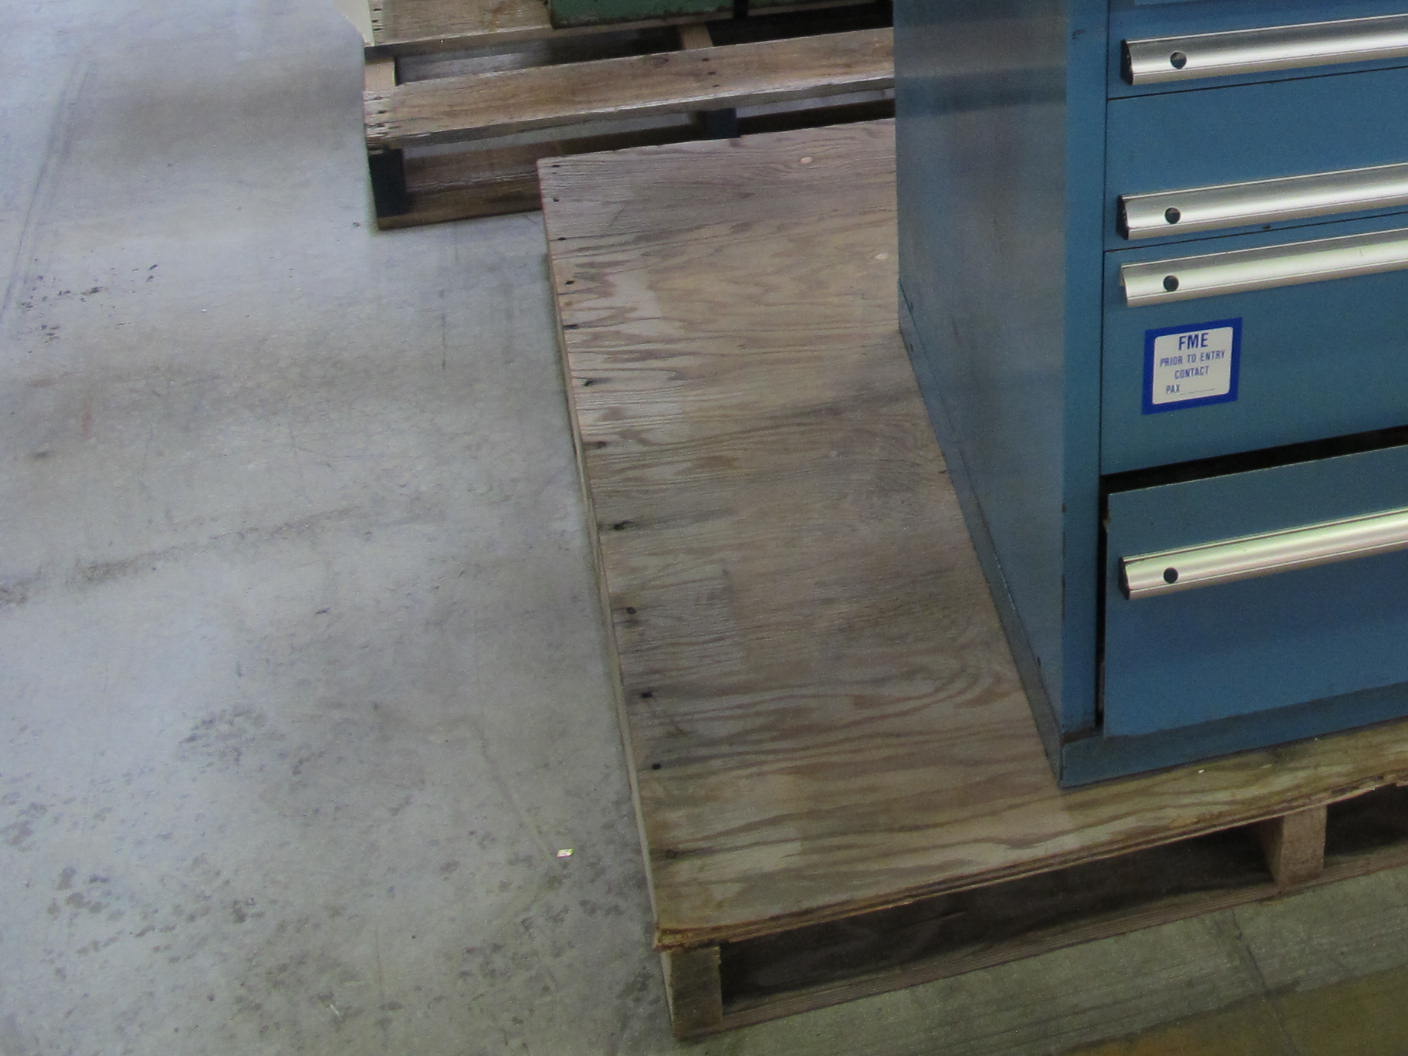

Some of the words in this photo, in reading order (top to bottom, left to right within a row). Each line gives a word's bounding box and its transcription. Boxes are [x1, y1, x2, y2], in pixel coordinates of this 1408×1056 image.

[1178, 333, 1209, 351] FME
[1160, 356, 1183, 367] PRIOR
[1187, 353, 1197, 363] TO
[1200, 350, 1225, 362] ENTRY
[1175, 365, 1209, 379] CONTACT
[1166, 384, 1180, 394] PAX
